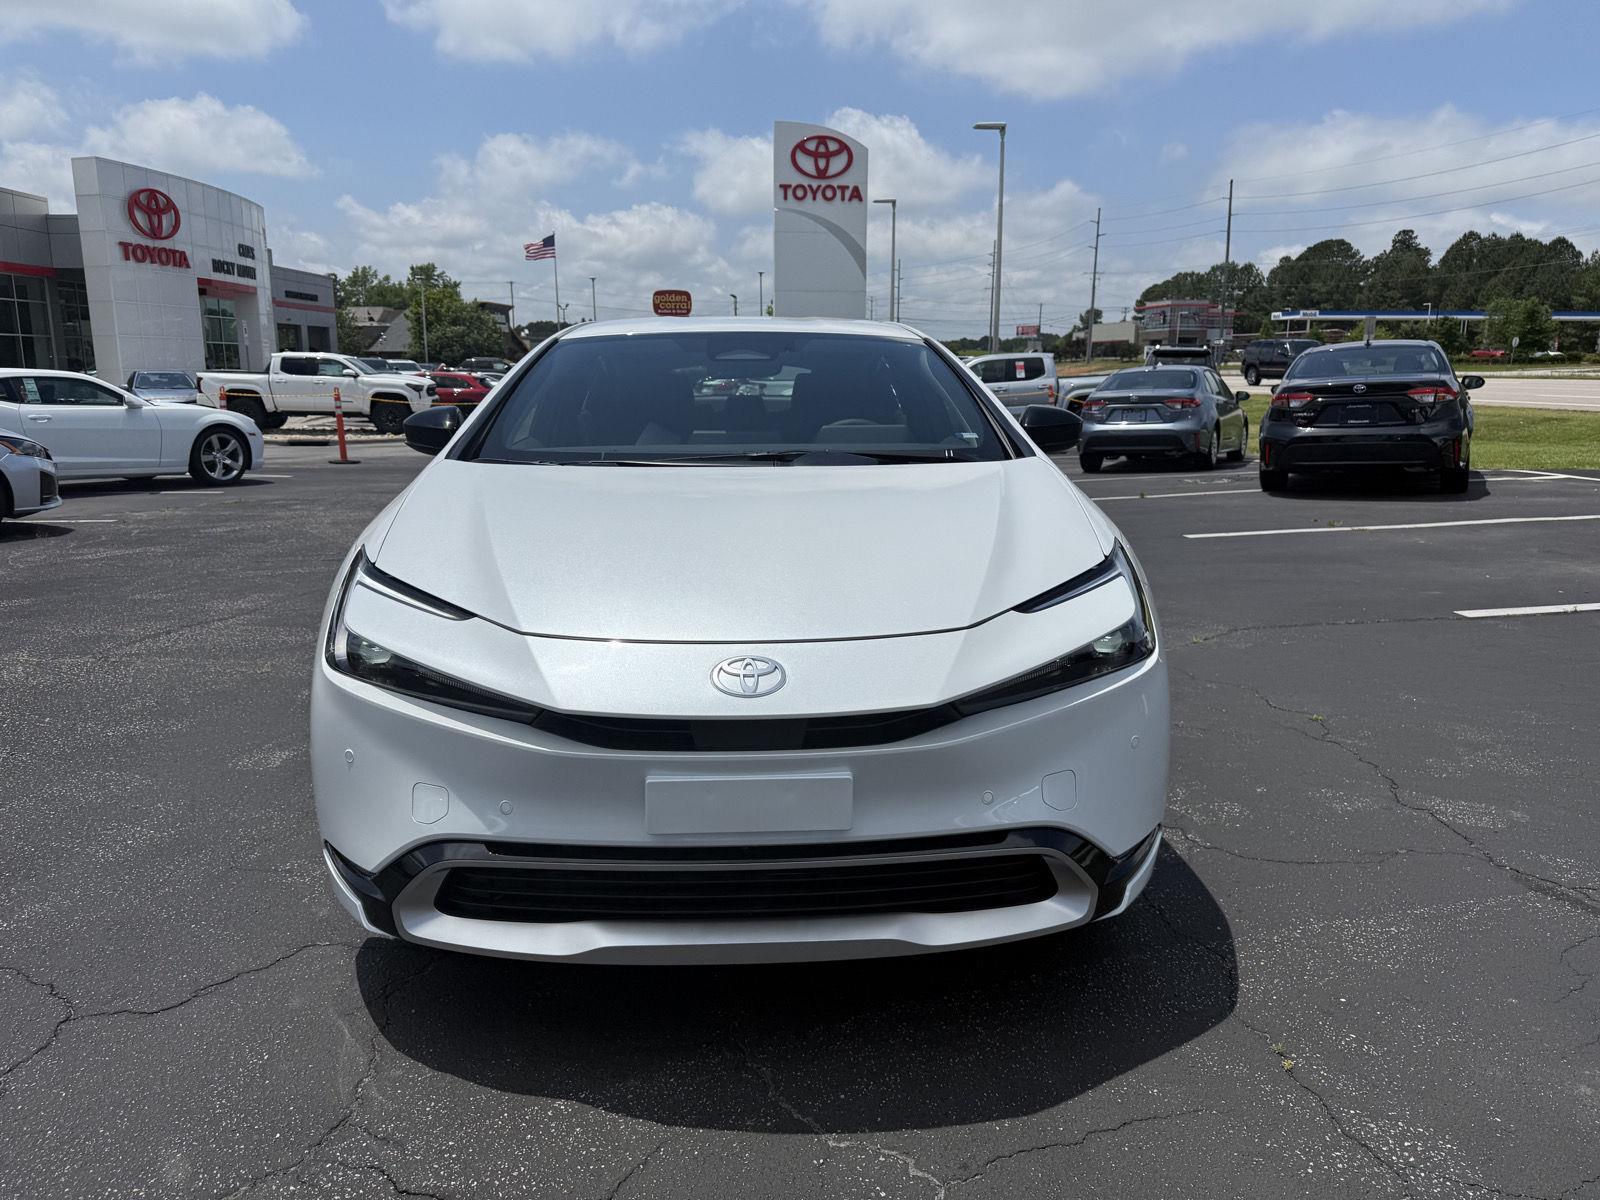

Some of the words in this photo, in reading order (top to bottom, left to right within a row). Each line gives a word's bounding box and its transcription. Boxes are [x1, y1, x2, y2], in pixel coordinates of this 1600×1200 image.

[779, 184, 863, 202] TOYOTA
[119, 241, 191, 268] TOYOTA
[212, 258, 235, 276] ROCKY
[655, 294, 687, 303] golden
[660, 301, 691, 309] corral
